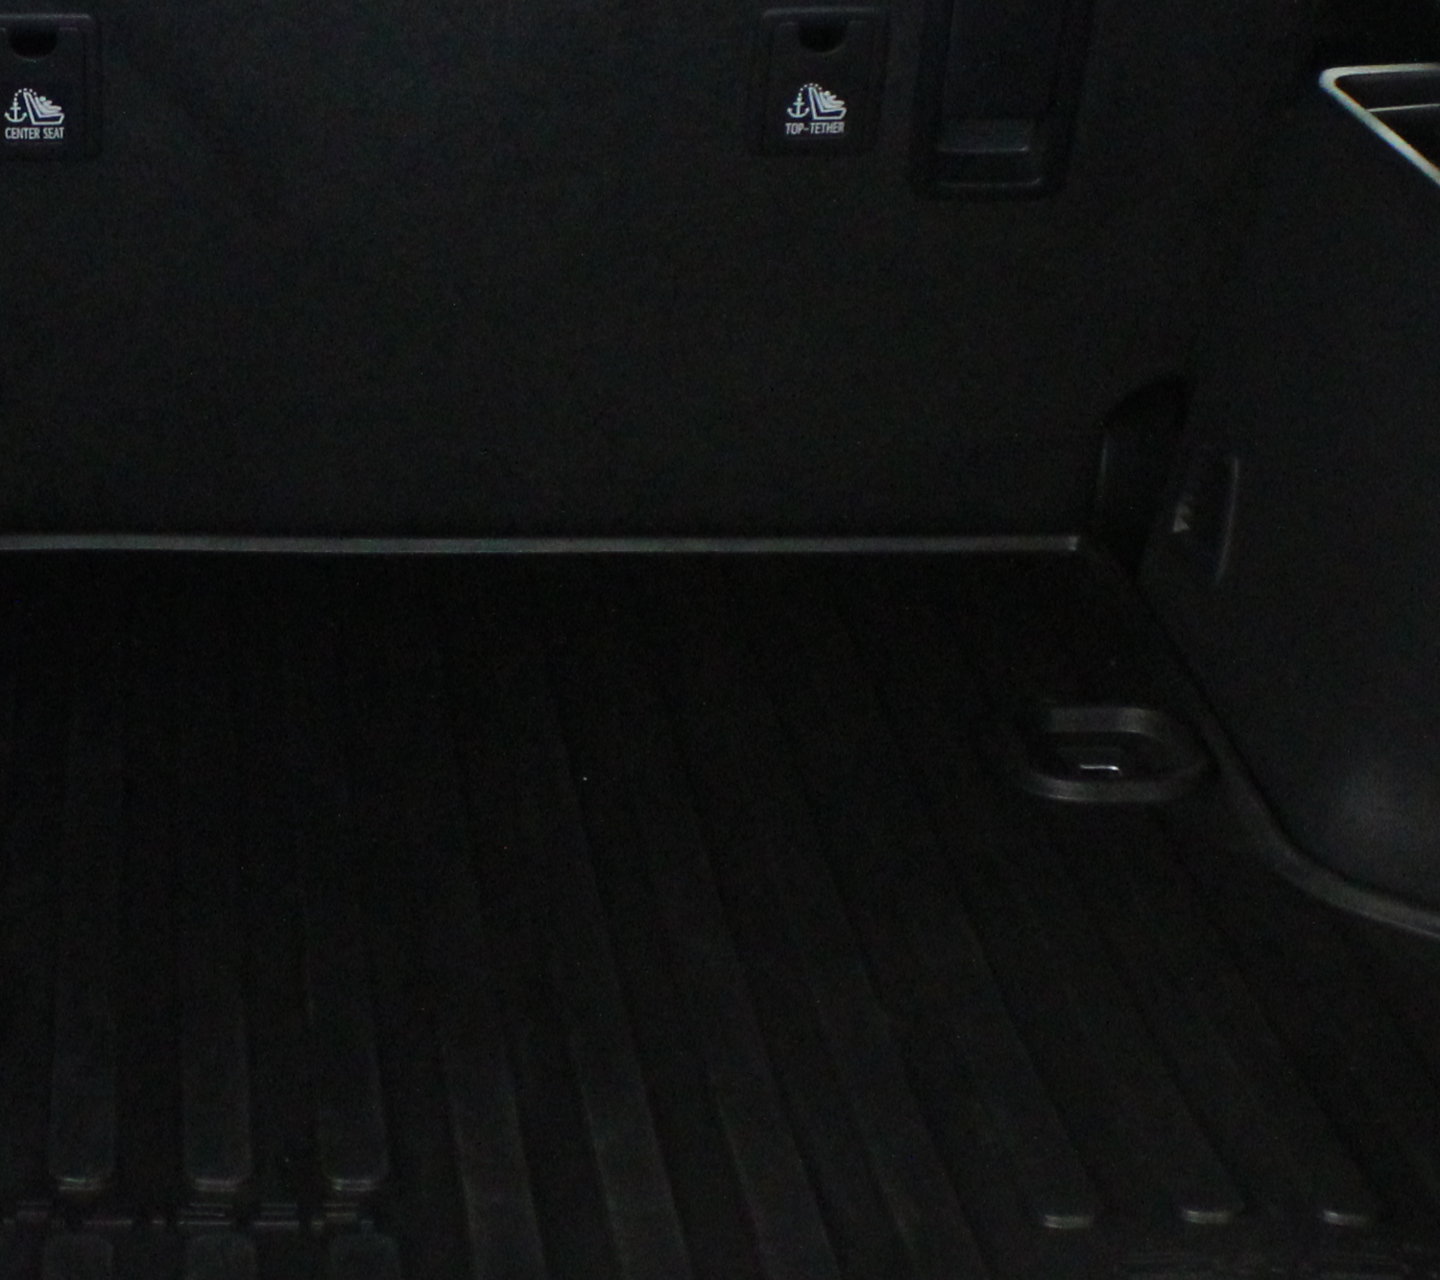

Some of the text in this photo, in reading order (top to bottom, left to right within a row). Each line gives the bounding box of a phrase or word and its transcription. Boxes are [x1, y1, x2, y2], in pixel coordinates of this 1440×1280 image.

[4, 127, 65, 140] CENTER SEAT
[785, 122, 844, 135] TOP-TETHER
